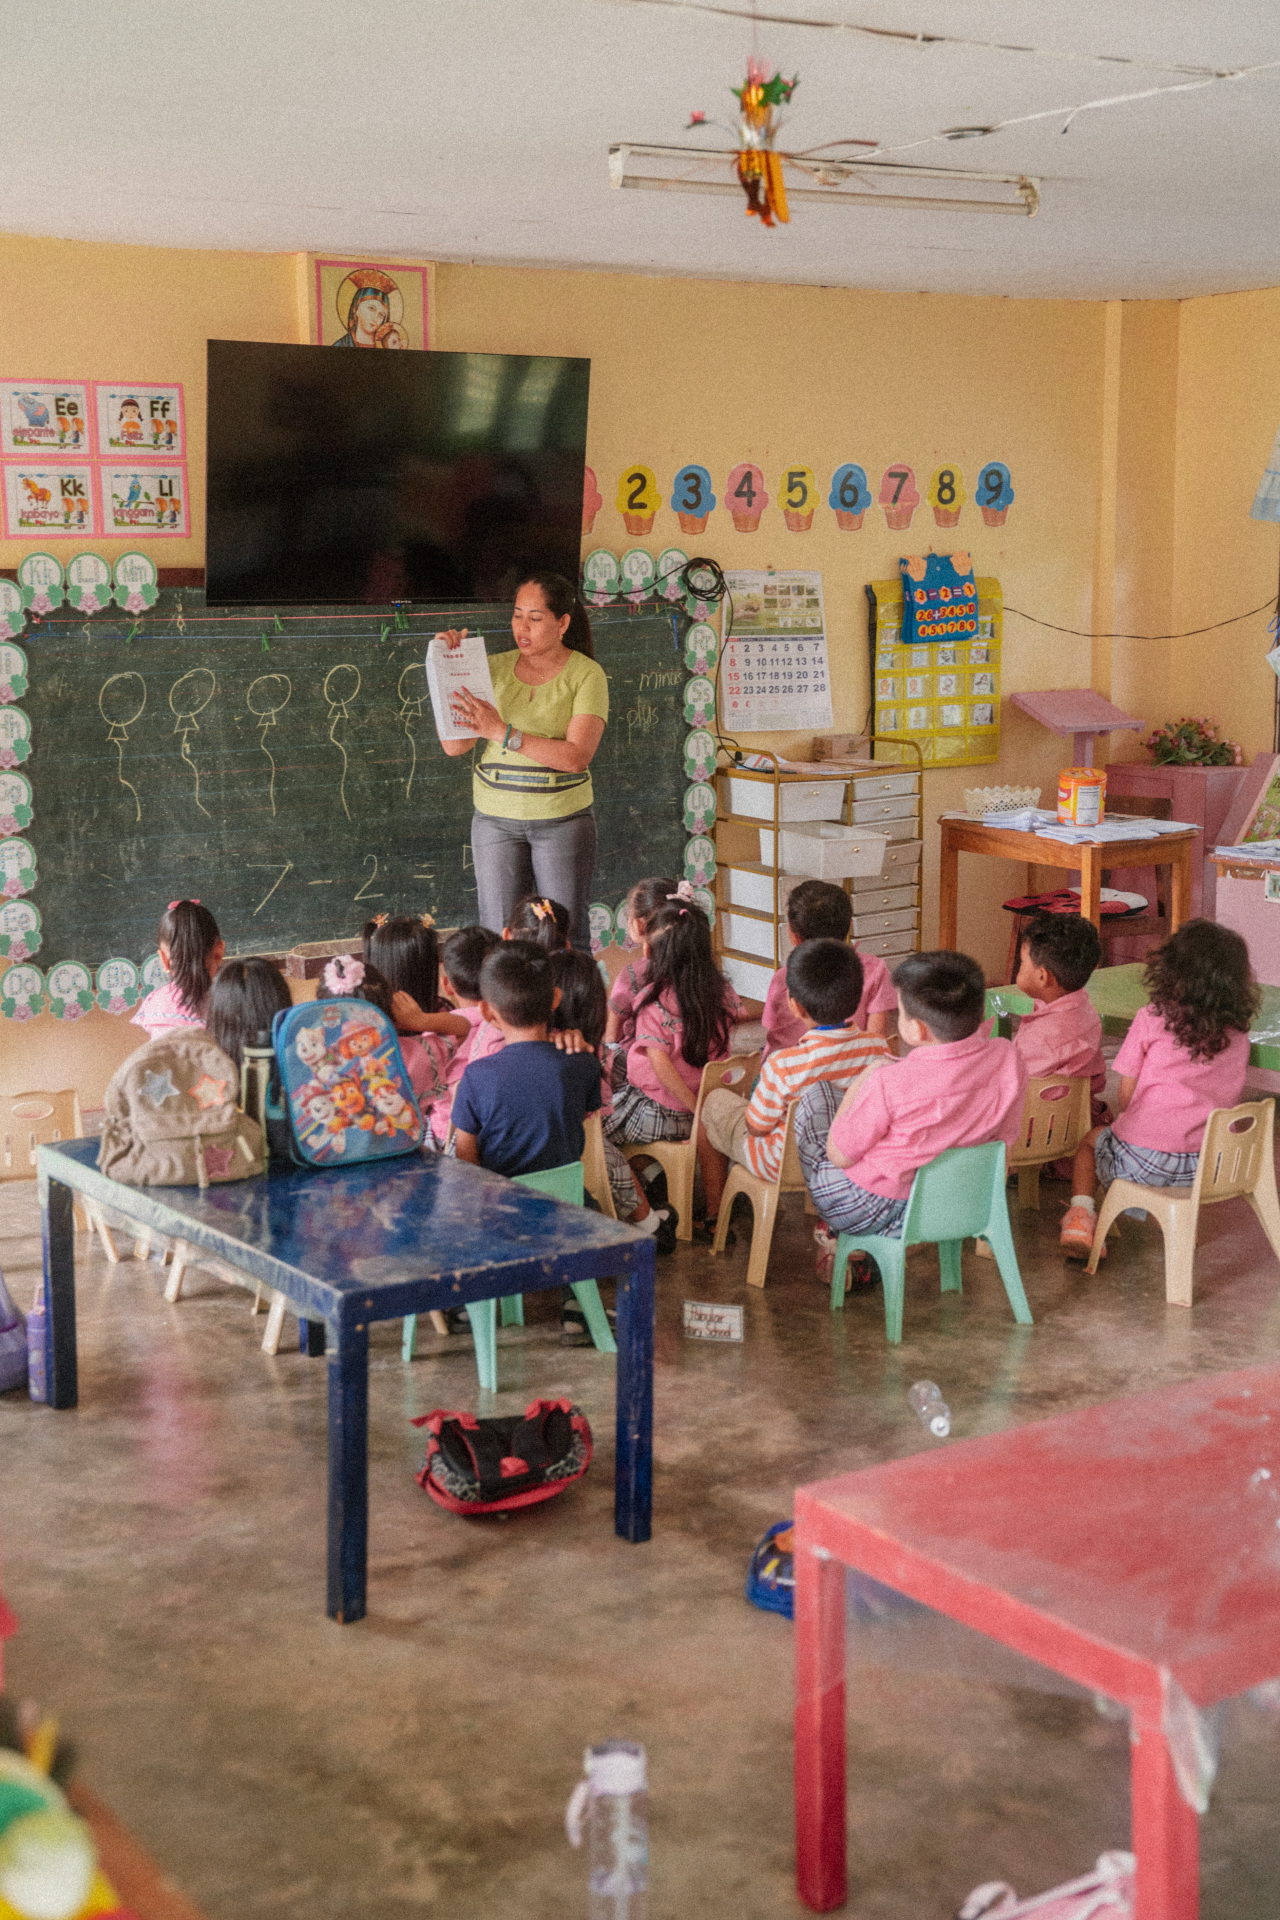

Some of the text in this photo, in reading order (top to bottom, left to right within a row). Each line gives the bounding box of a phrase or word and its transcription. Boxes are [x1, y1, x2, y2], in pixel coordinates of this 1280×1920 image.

[55, 398, 78, 416] Ee
[150, 400, 170, 418] Ff
[12, 426, 55, 438] elepante
[60, 479, 85, 497] Kk
[627, 472, 647, 509] 2
[683, 472, 702, 510] 3
[734, 470, 756, 508] 4
[787, 471, 808, 508] 5
[839, 471, 859, 508] 6
[888, 471, 909, 507] 7
[938, 470, 955, 505] 8
[989, 469, 1002, 507] 9
[21, 508, 60, 520] kabayo
[113, 508, 154, 520] langgam
[729, 643, 820, 653] 1 2 3 4 5 6 7
[729, 656, 824, 667] 8 9 10 11 12 13 14
[640, 661, 682, 691] minus
[728, 670, 825, 681] 15 16 17 18 19 20 21
[728, 683, 826, 695] 22 23 24 25 26 27 28
[247, 862, 294, 916] 7
[354, 854, 384, 900] 2
